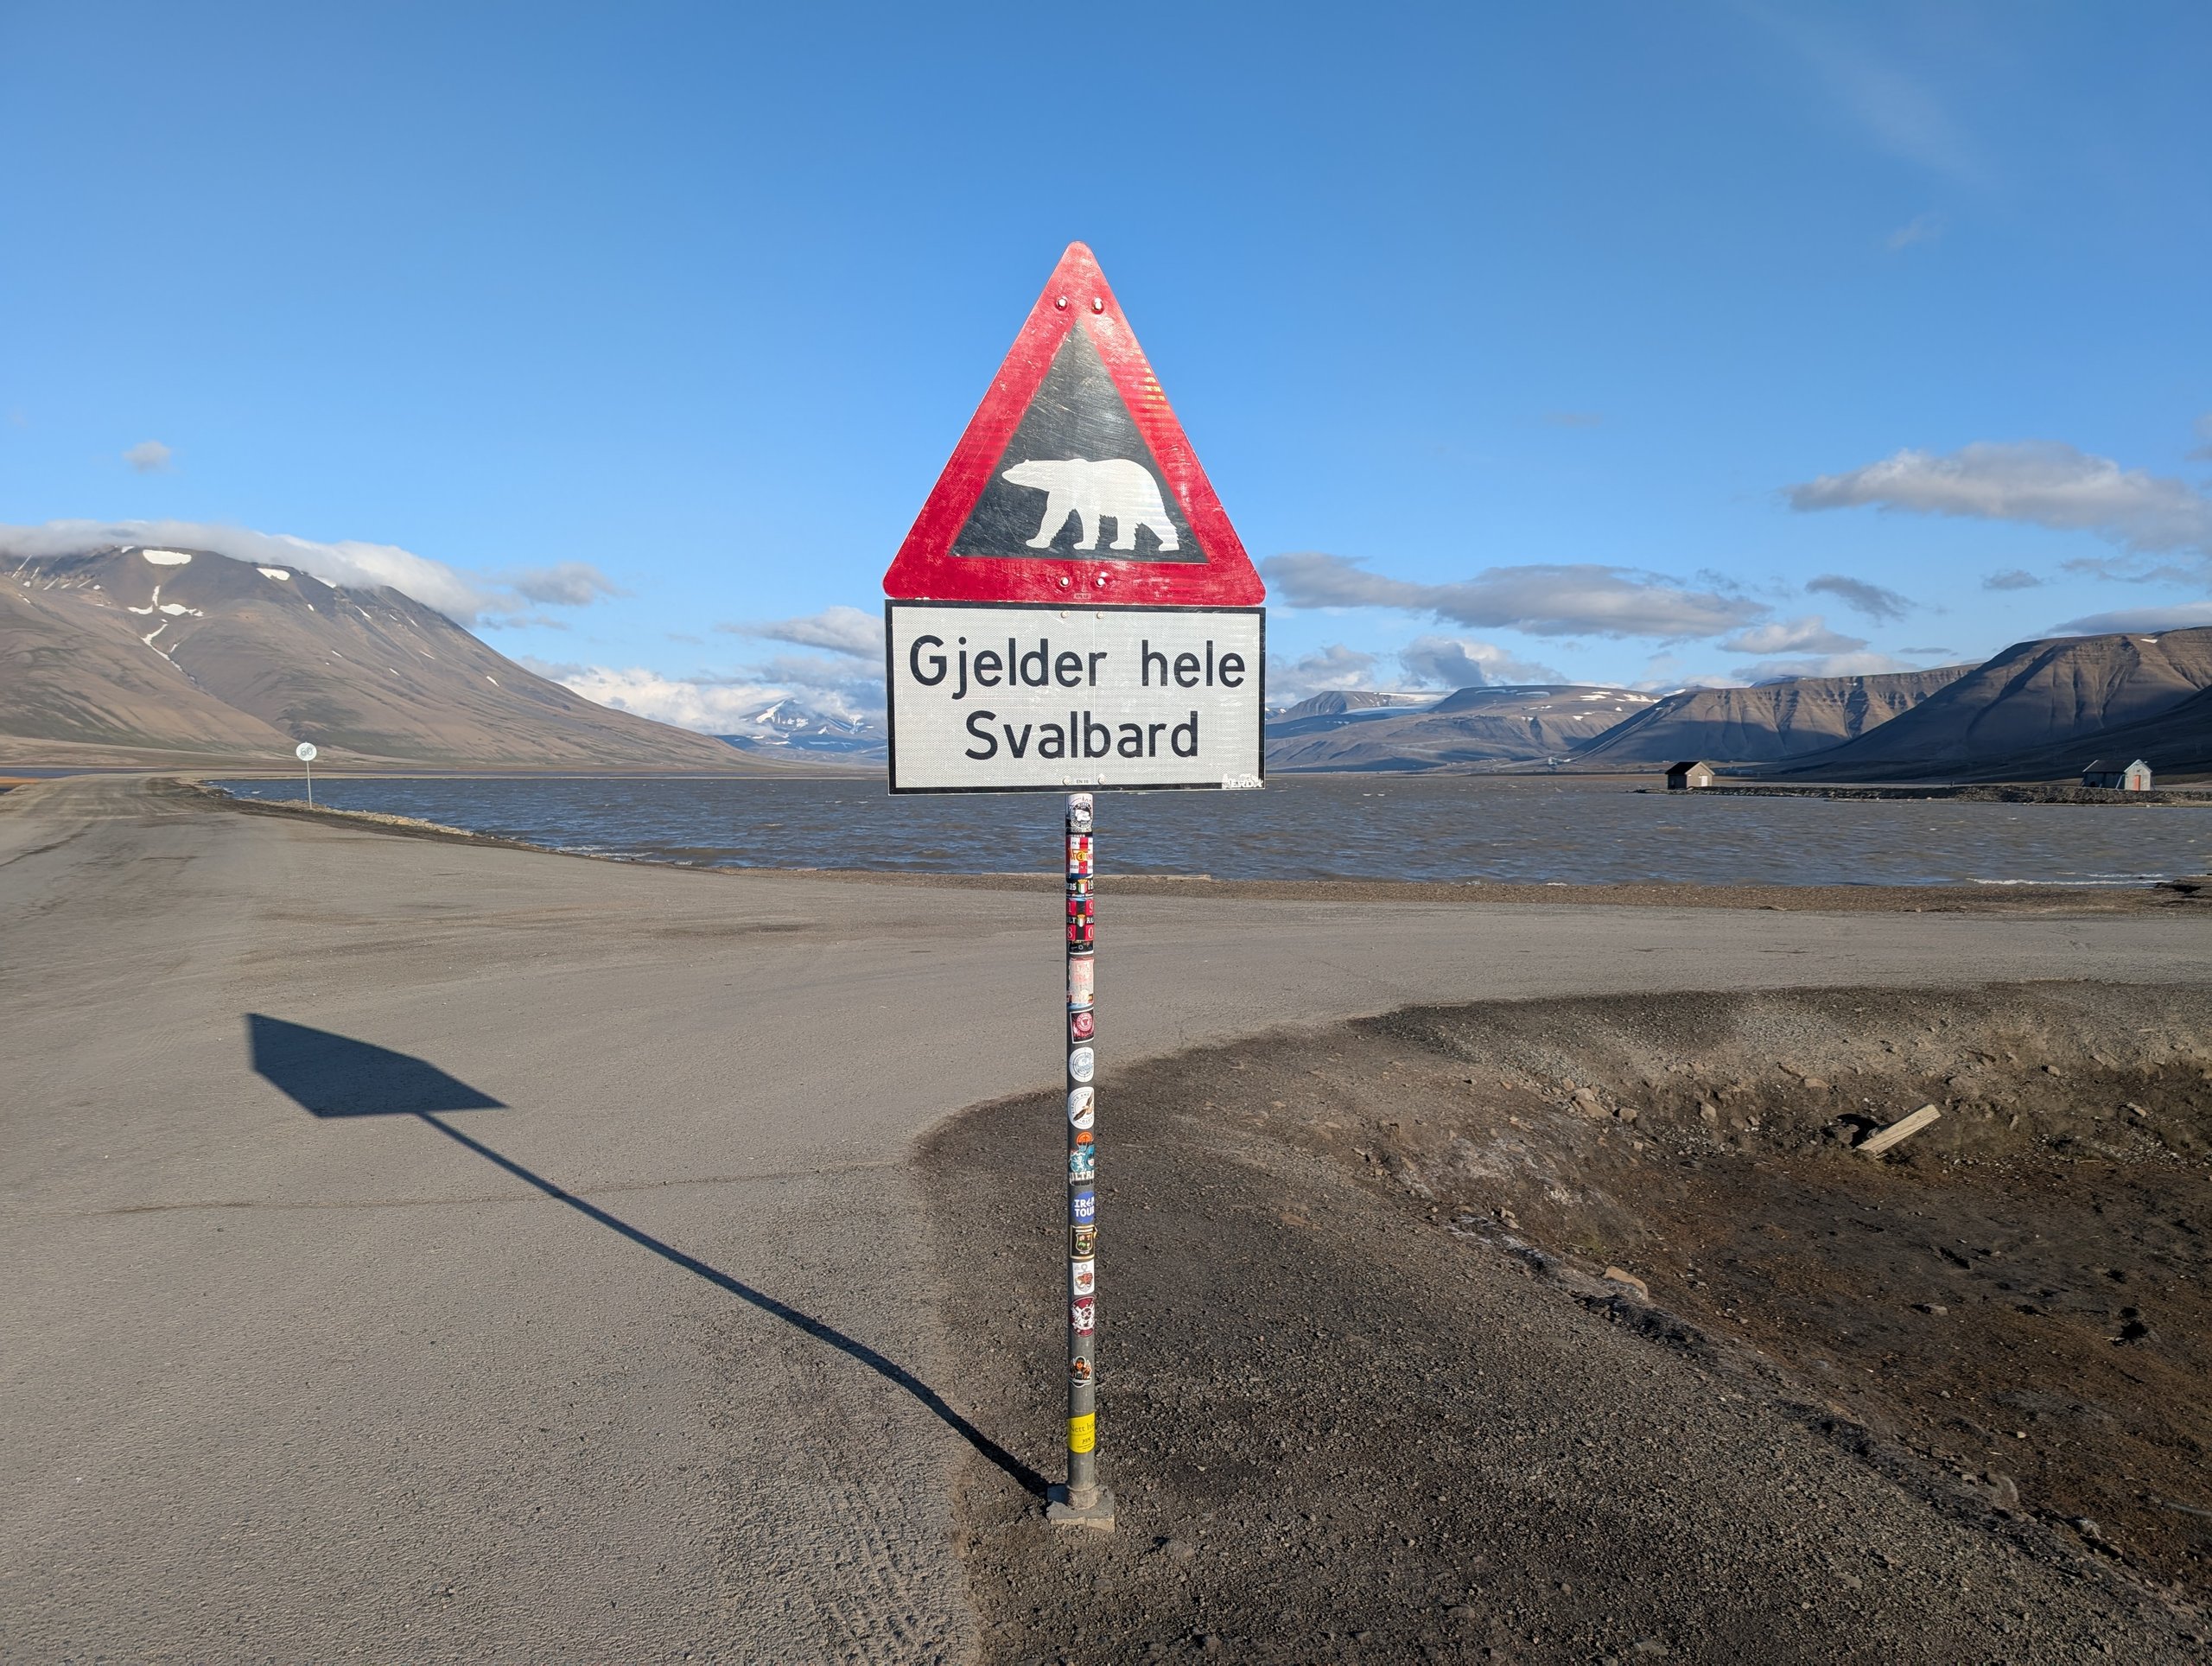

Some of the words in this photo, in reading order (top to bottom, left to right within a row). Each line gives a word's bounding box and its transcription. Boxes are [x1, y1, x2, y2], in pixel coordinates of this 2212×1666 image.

[910, 635, 1107, 699] Gjelder
[1142, 640, 1245, 688] hele
[965, 710, 1198, 760] Svalbard
